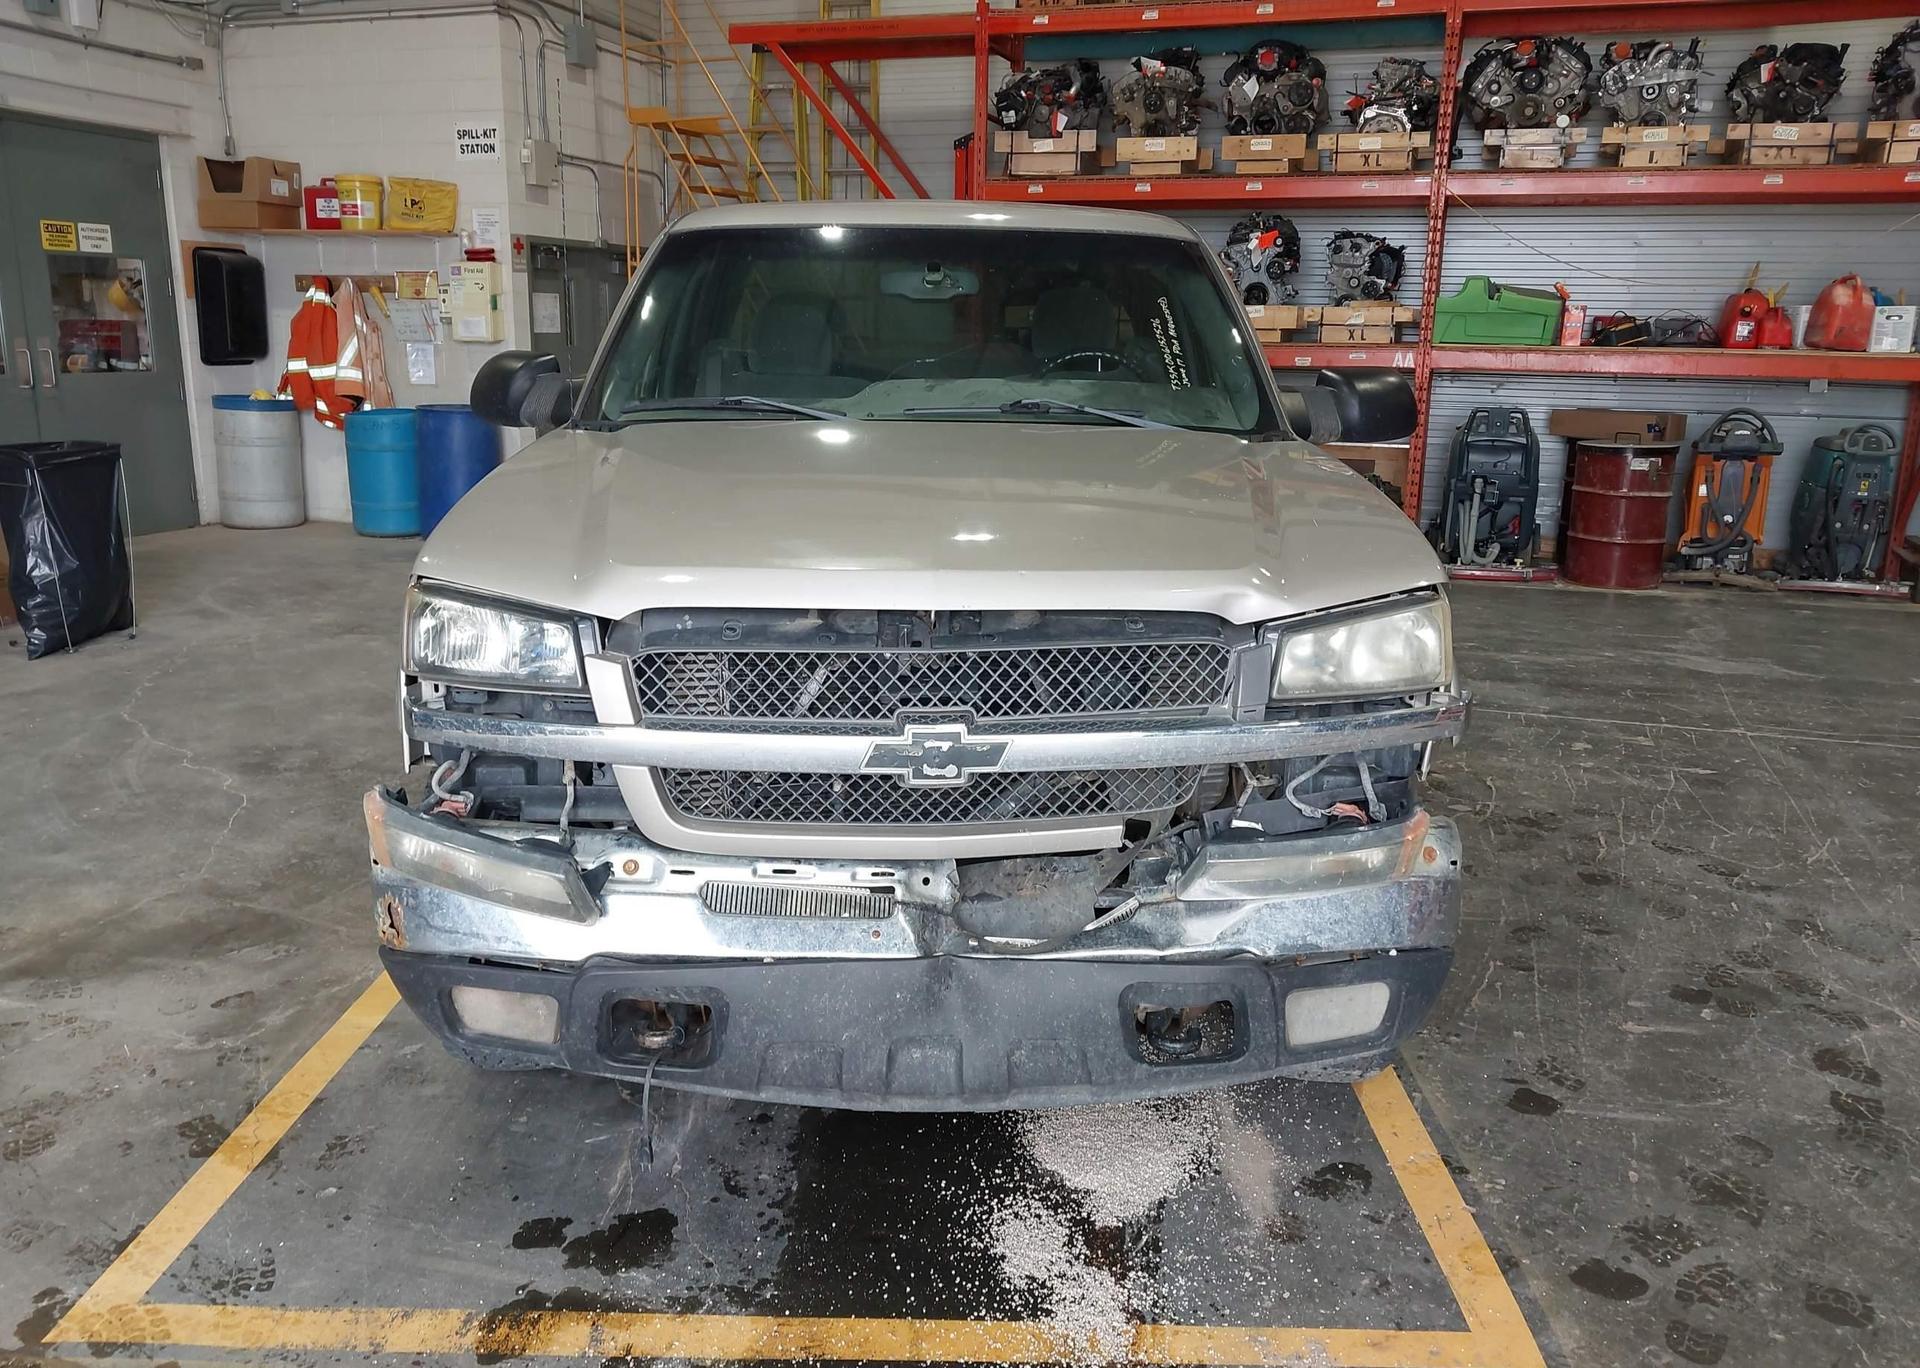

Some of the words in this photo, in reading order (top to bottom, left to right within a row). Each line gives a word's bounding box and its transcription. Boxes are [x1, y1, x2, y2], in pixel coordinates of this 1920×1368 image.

[456, 128, 496, 140] SPILL-KIT
[459, 143, 496, 154] STATION
[1363, 154, 1382, 167] XL
[43, 224, 72, 233] CAUTION
[1348, 329, 1367, 341] XL
[1391, 350, 1416, 368] AA
